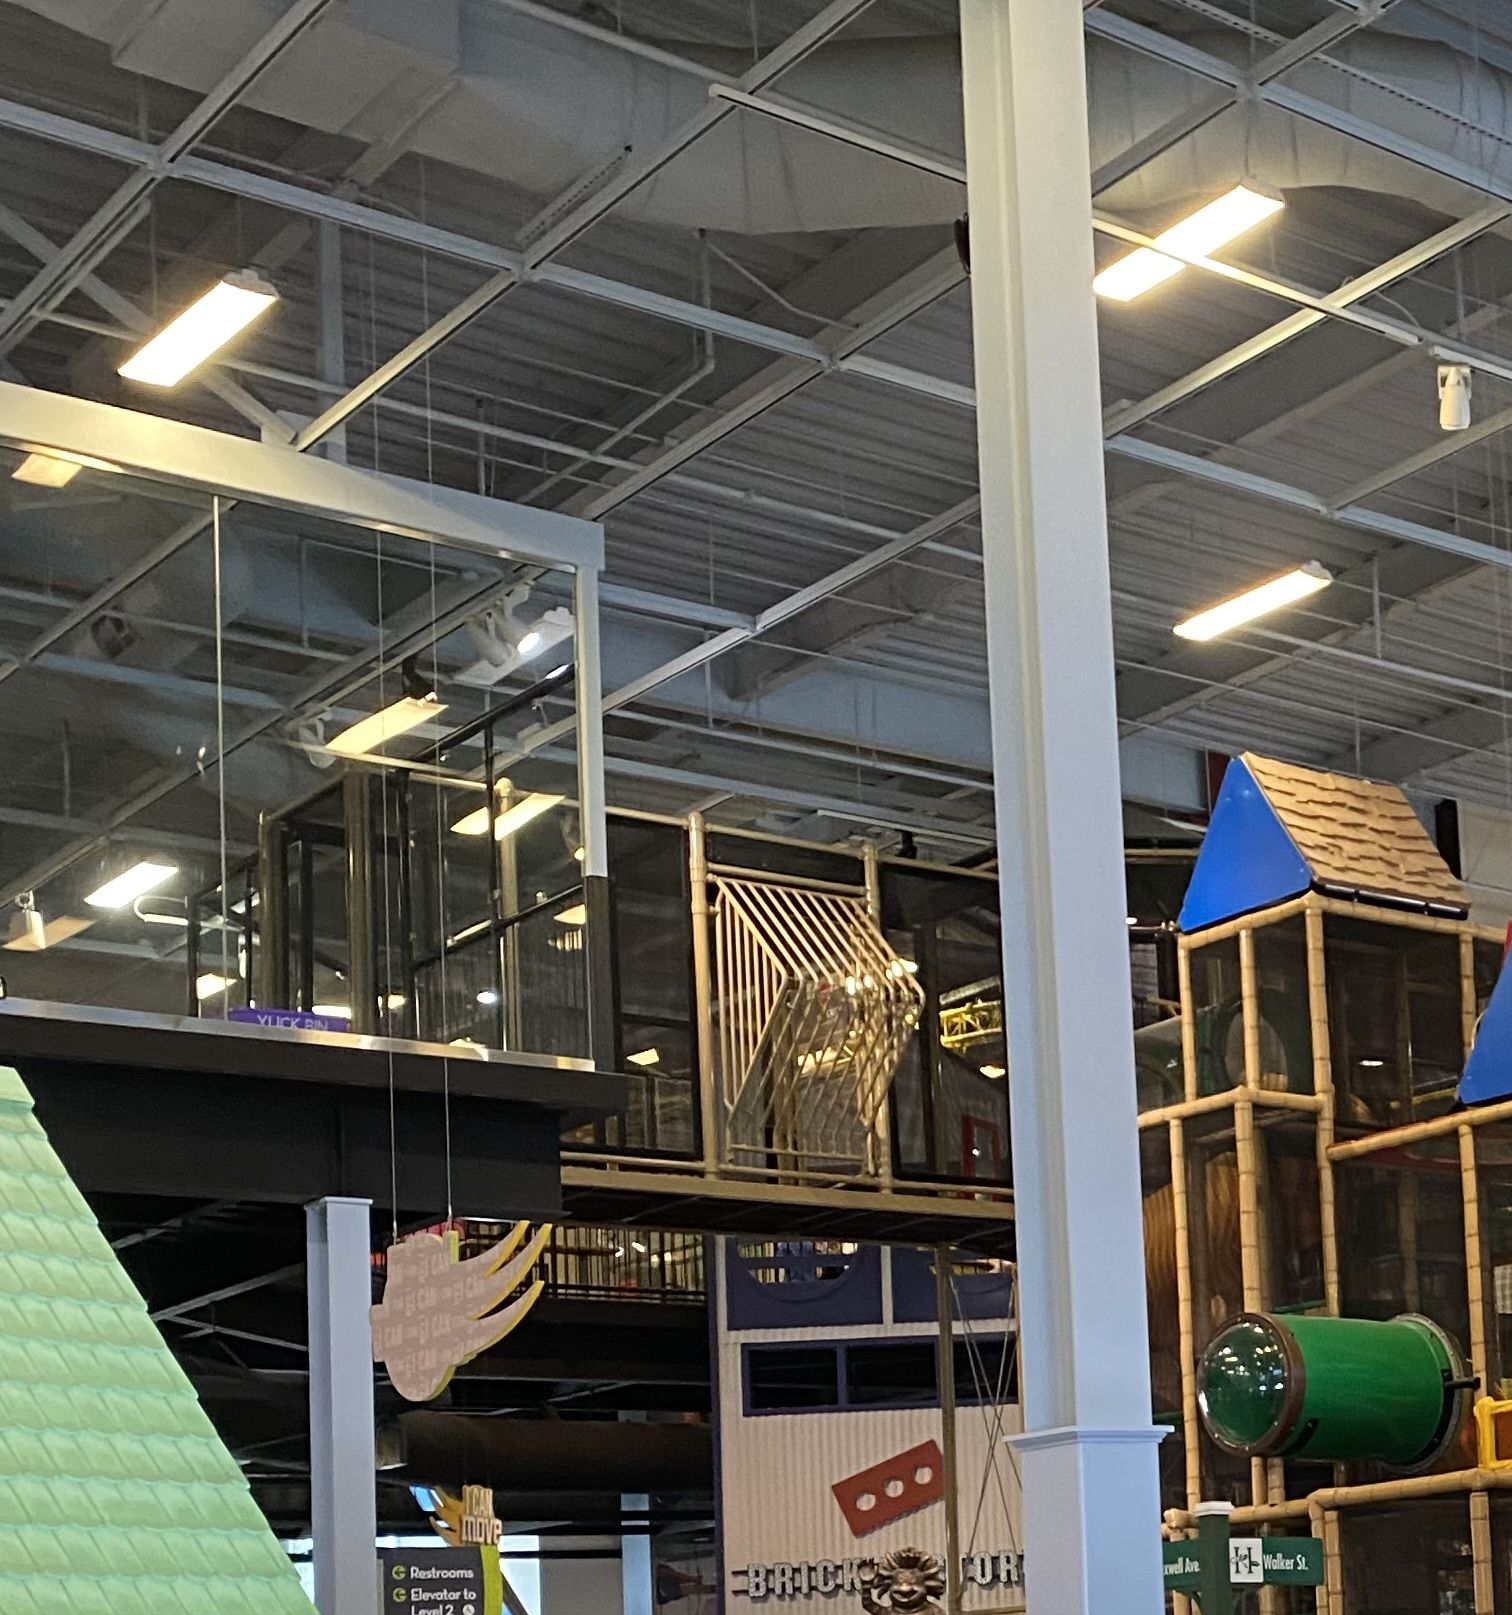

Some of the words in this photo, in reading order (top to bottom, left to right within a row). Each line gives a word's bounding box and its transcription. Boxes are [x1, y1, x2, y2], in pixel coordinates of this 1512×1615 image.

[461, 1516, 502, 1544] move
[1263, 1552, 1295, 1571] Walker
[410, 1565, 475, 1580] Restrooms
[746, 1556, 865, 1600] BRICK
[410, 1587, 461, 1602] Elevator
[463, 1588, 477, 1601] to
